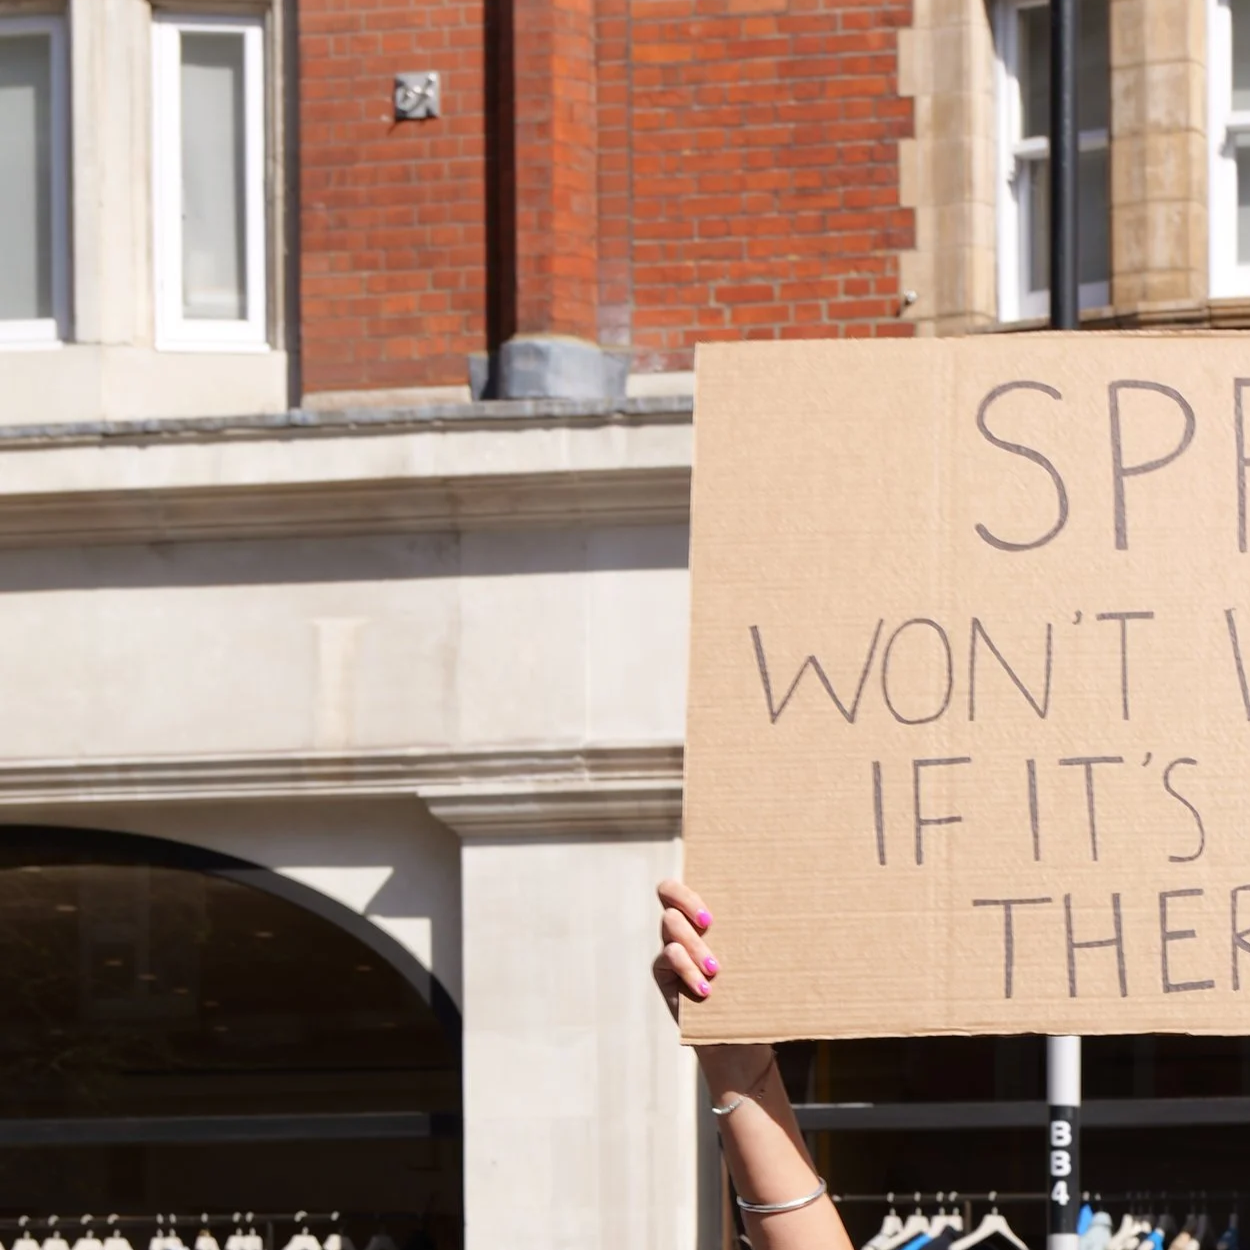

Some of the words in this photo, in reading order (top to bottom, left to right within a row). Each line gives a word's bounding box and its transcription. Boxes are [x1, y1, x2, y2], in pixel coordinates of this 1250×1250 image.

[749, 611, 1154, 725] WON'T
[872, 757, 972, 866] IF
[1026, 752, 1205, 862] IT'S
